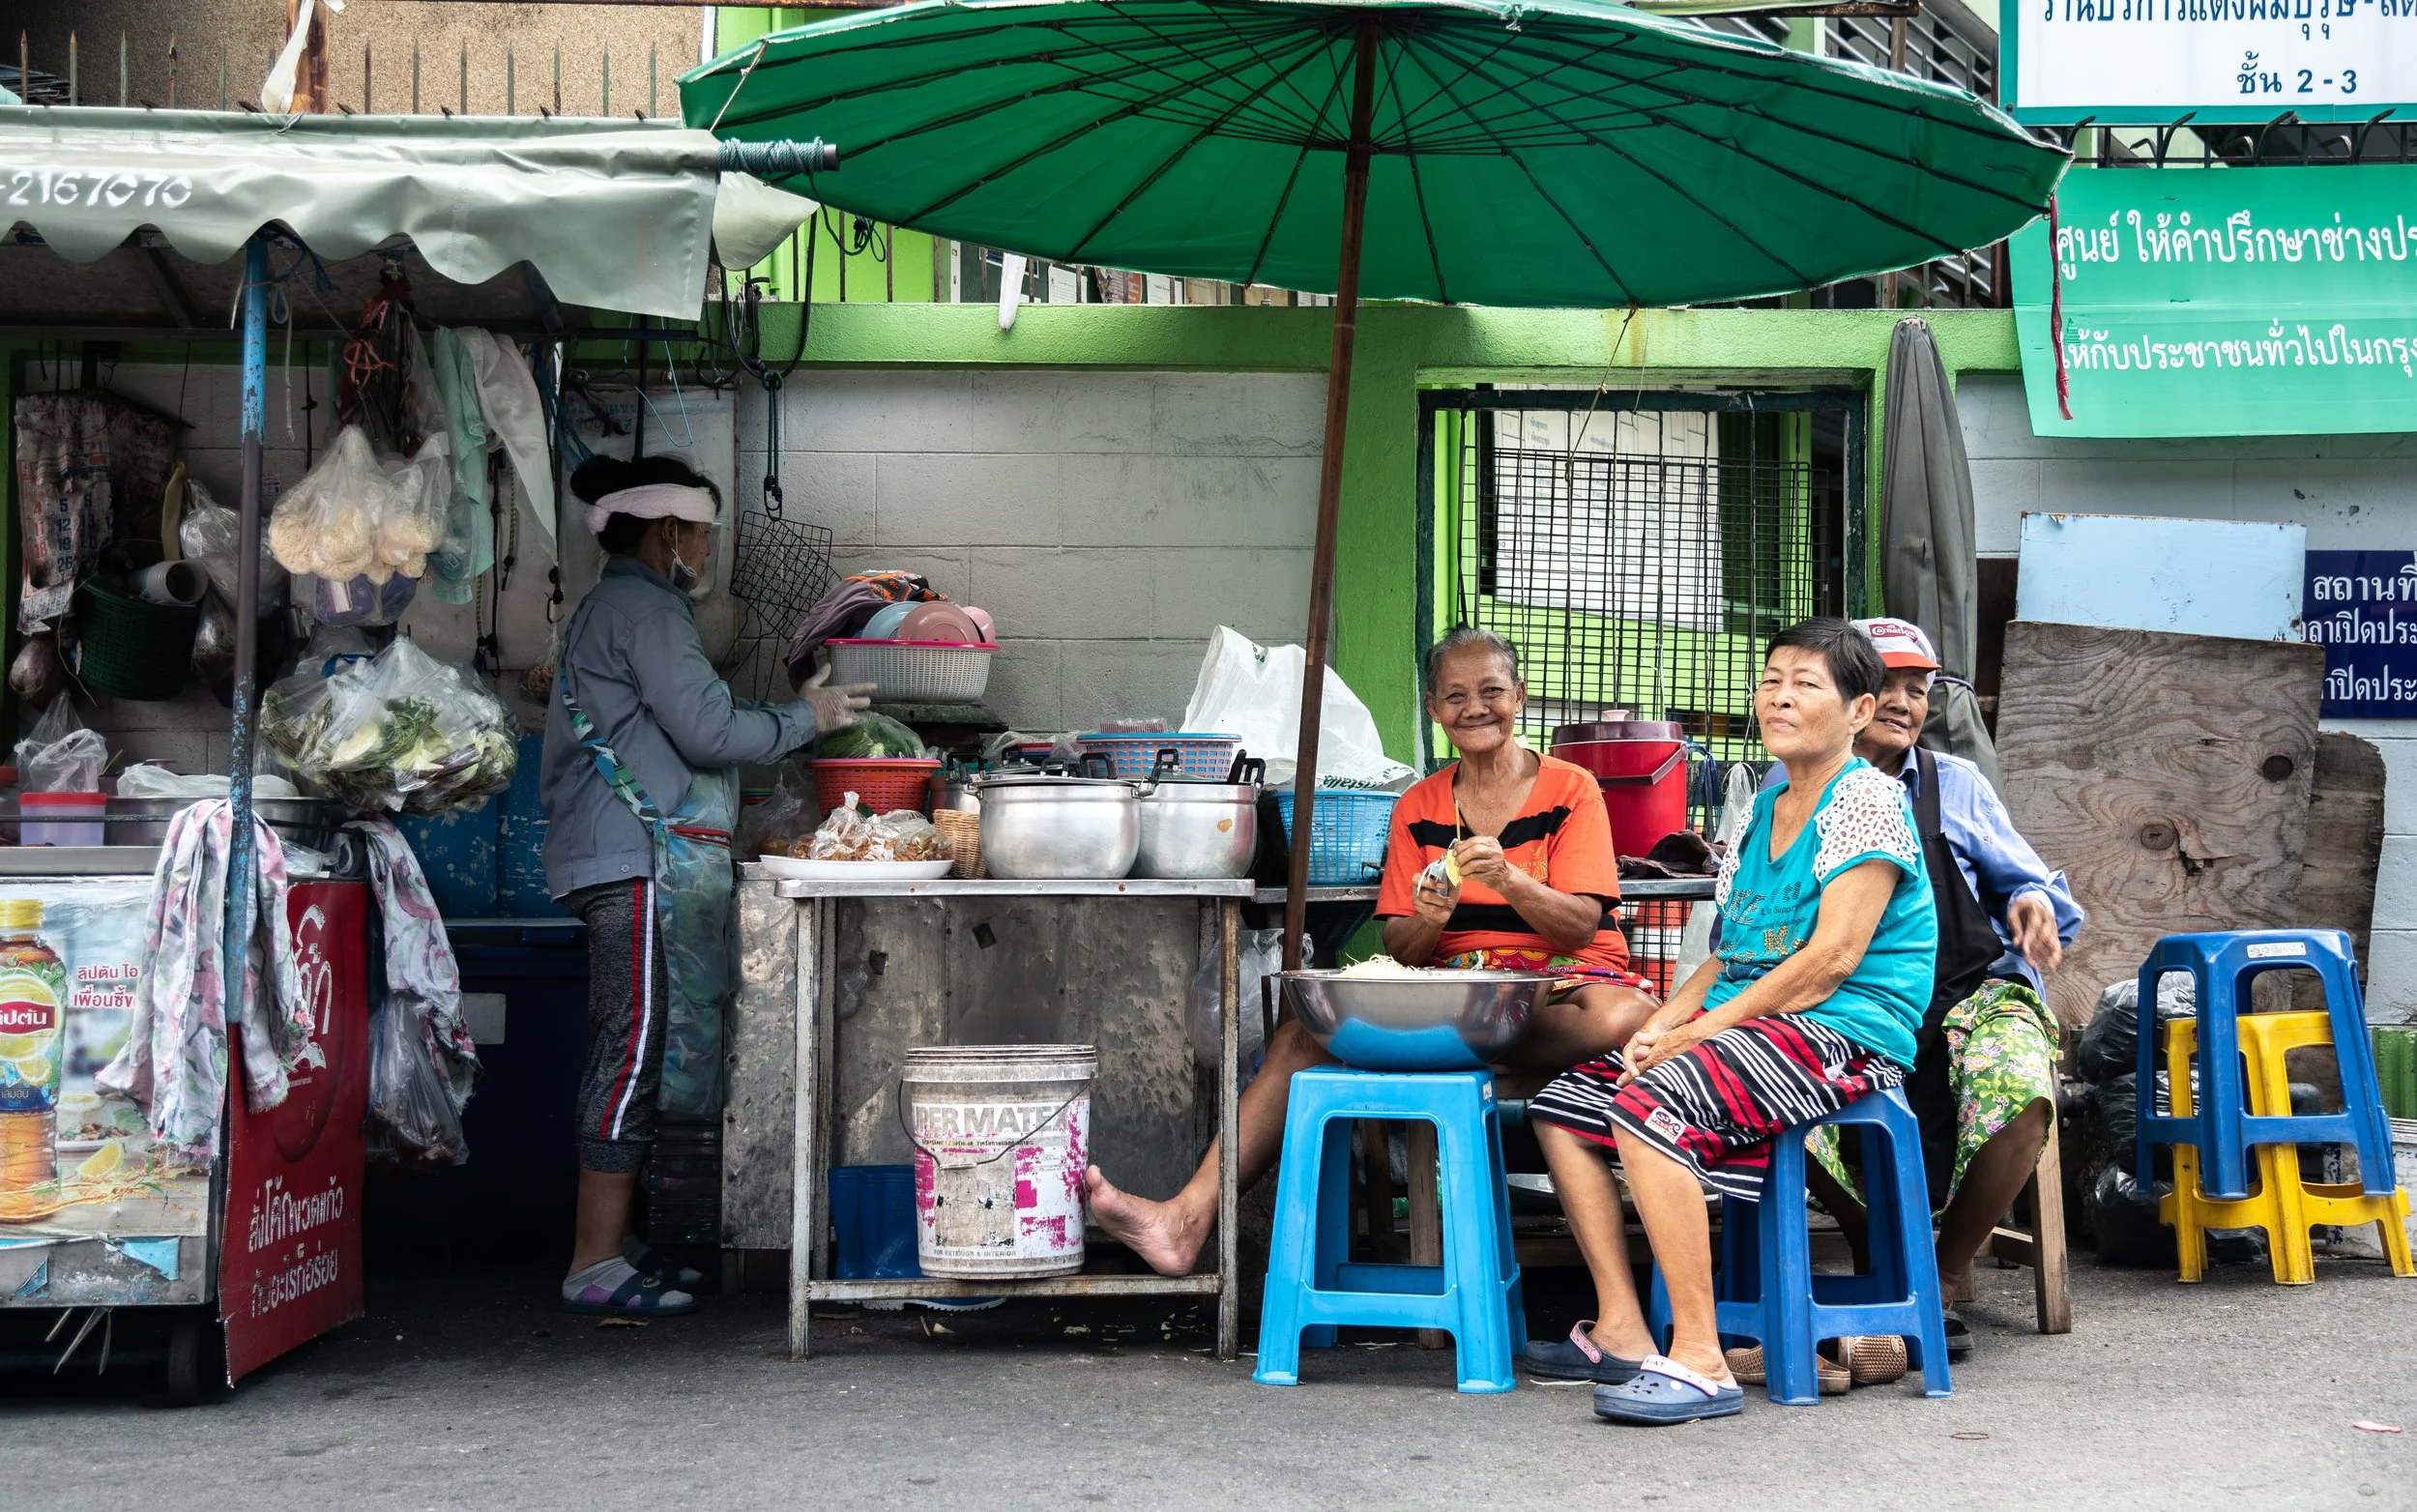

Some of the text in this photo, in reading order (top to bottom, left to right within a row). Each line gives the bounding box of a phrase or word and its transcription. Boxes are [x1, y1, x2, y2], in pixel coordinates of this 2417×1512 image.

[2236, 50, 2283, 94] ชั้น
[2056, 210, 2120, 280] ศูนย์
[2320, 664, 2417, 701] าปิดประ
[77, 965, 119, 980] ลิปตัน
[73, 985, 135, 1007] เพื่อนซี้ข
